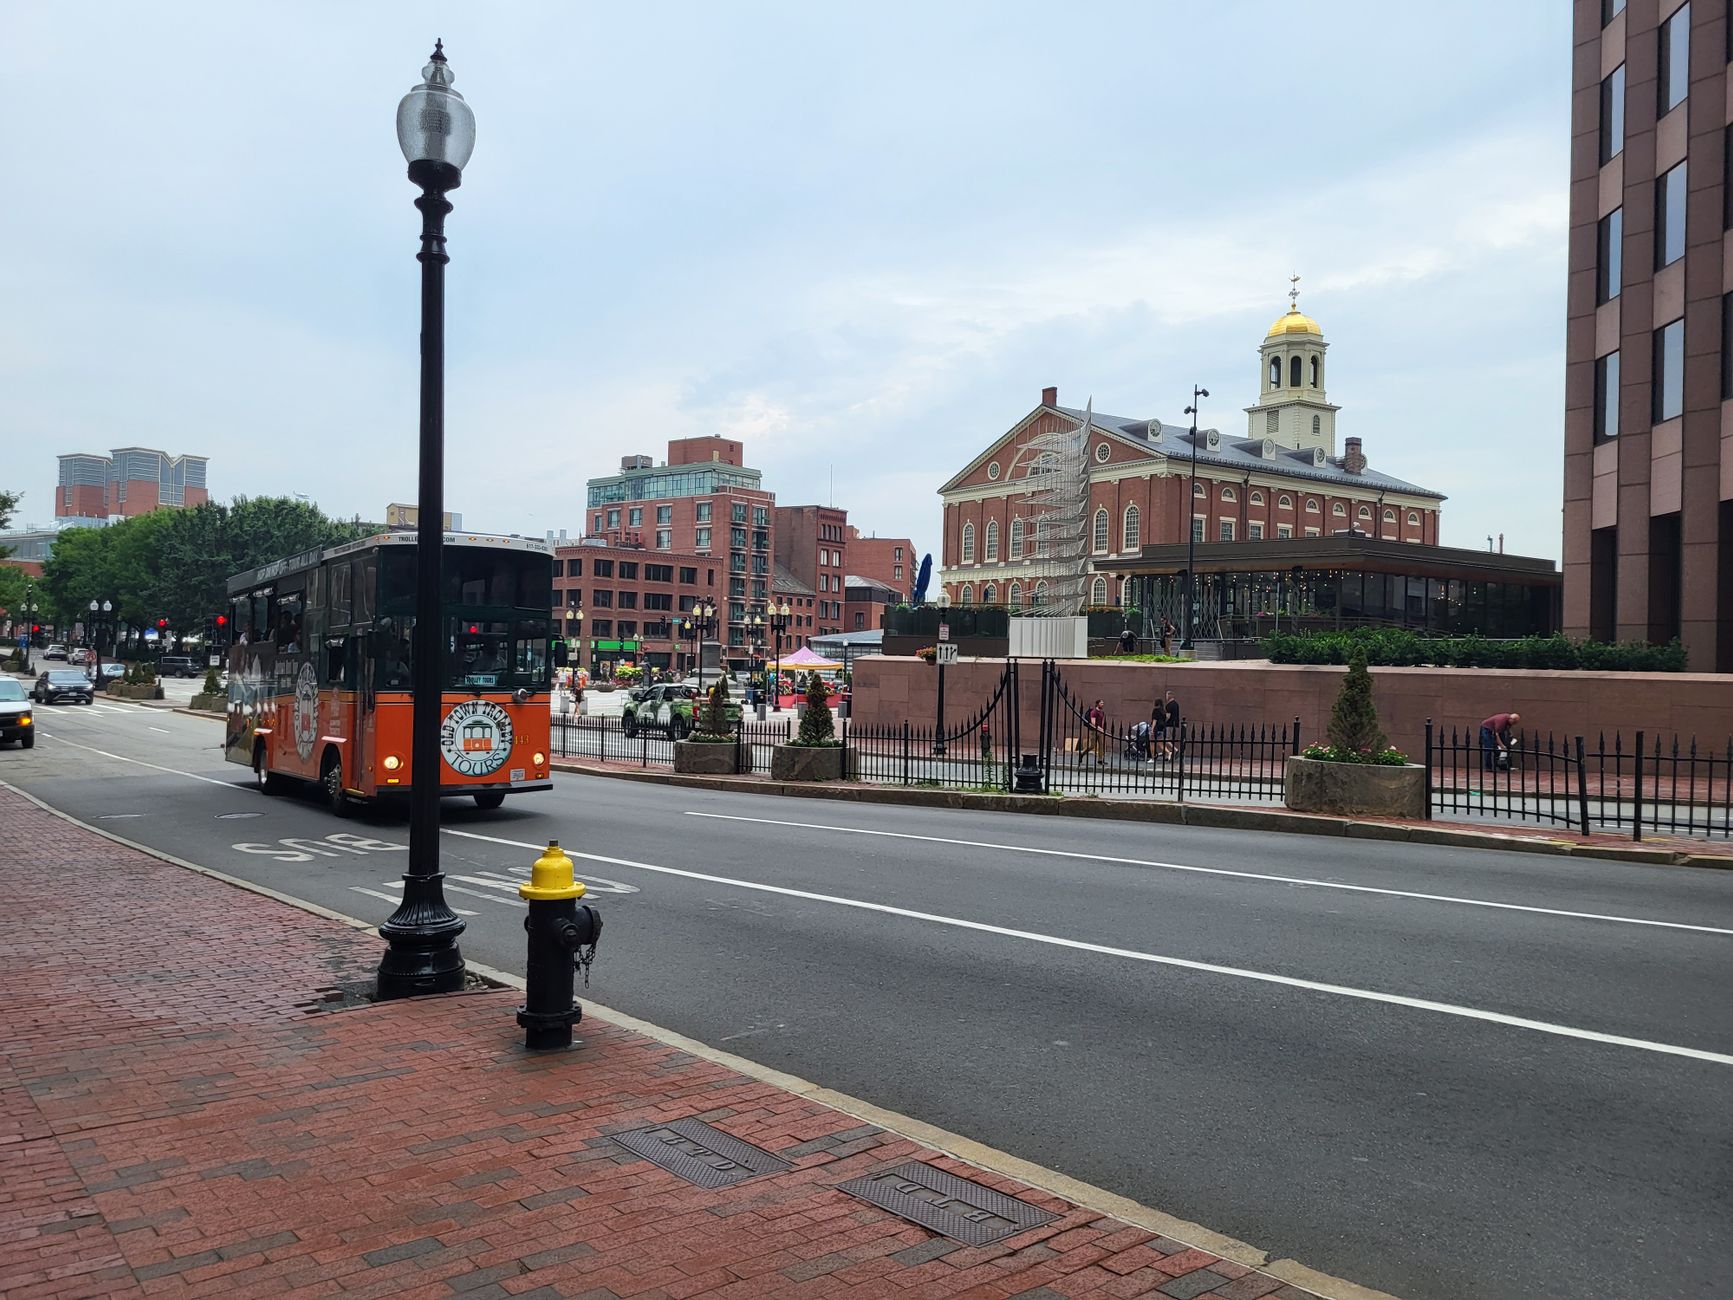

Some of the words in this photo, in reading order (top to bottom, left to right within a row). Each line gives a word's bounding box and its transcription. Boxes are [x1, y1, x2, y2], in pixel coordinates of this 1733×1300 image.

[441, 725, 455, 746] OLD
[448, 702, 479, 724] TOWN
[483, 701, 513, 745] TROLLEY
[450, 752, 505, 776] TOURS
[231, 833, 410, 862] BUS
[660, 1137, 737, 1171] BTD
[895, 1182, 996, 1223] BTD
